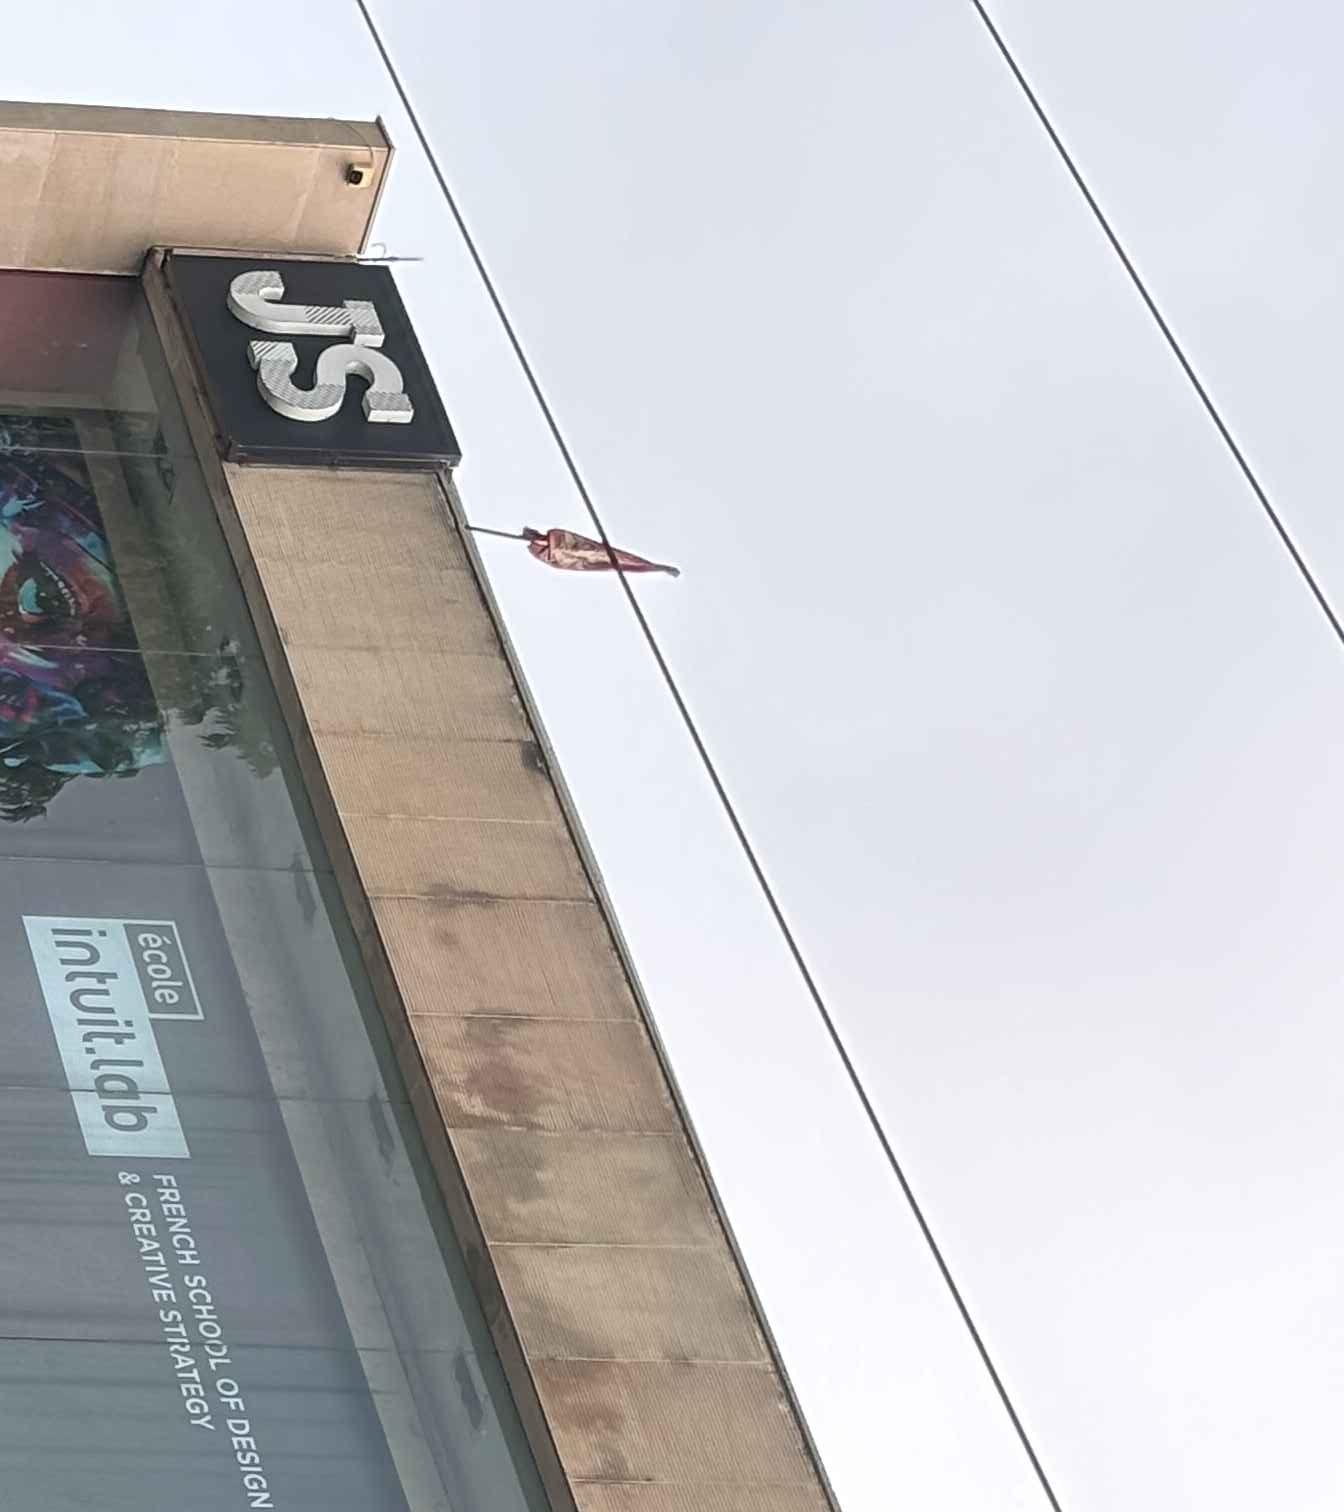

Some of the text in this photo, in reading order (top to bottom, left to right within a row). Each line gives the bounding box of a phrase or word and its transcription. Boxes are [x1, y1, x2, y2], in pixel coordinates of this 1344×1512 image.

[227, 271, 414, 423] JS
[51, 928, 158, 1132] intuit.lab
[138, 933, 183, 1004] école
[118, 1171, 215, 1430] & CREATIVE STRATEGY
[153, 1174, 274, 1508] FRENCH SCHOOL OF DESIGN
